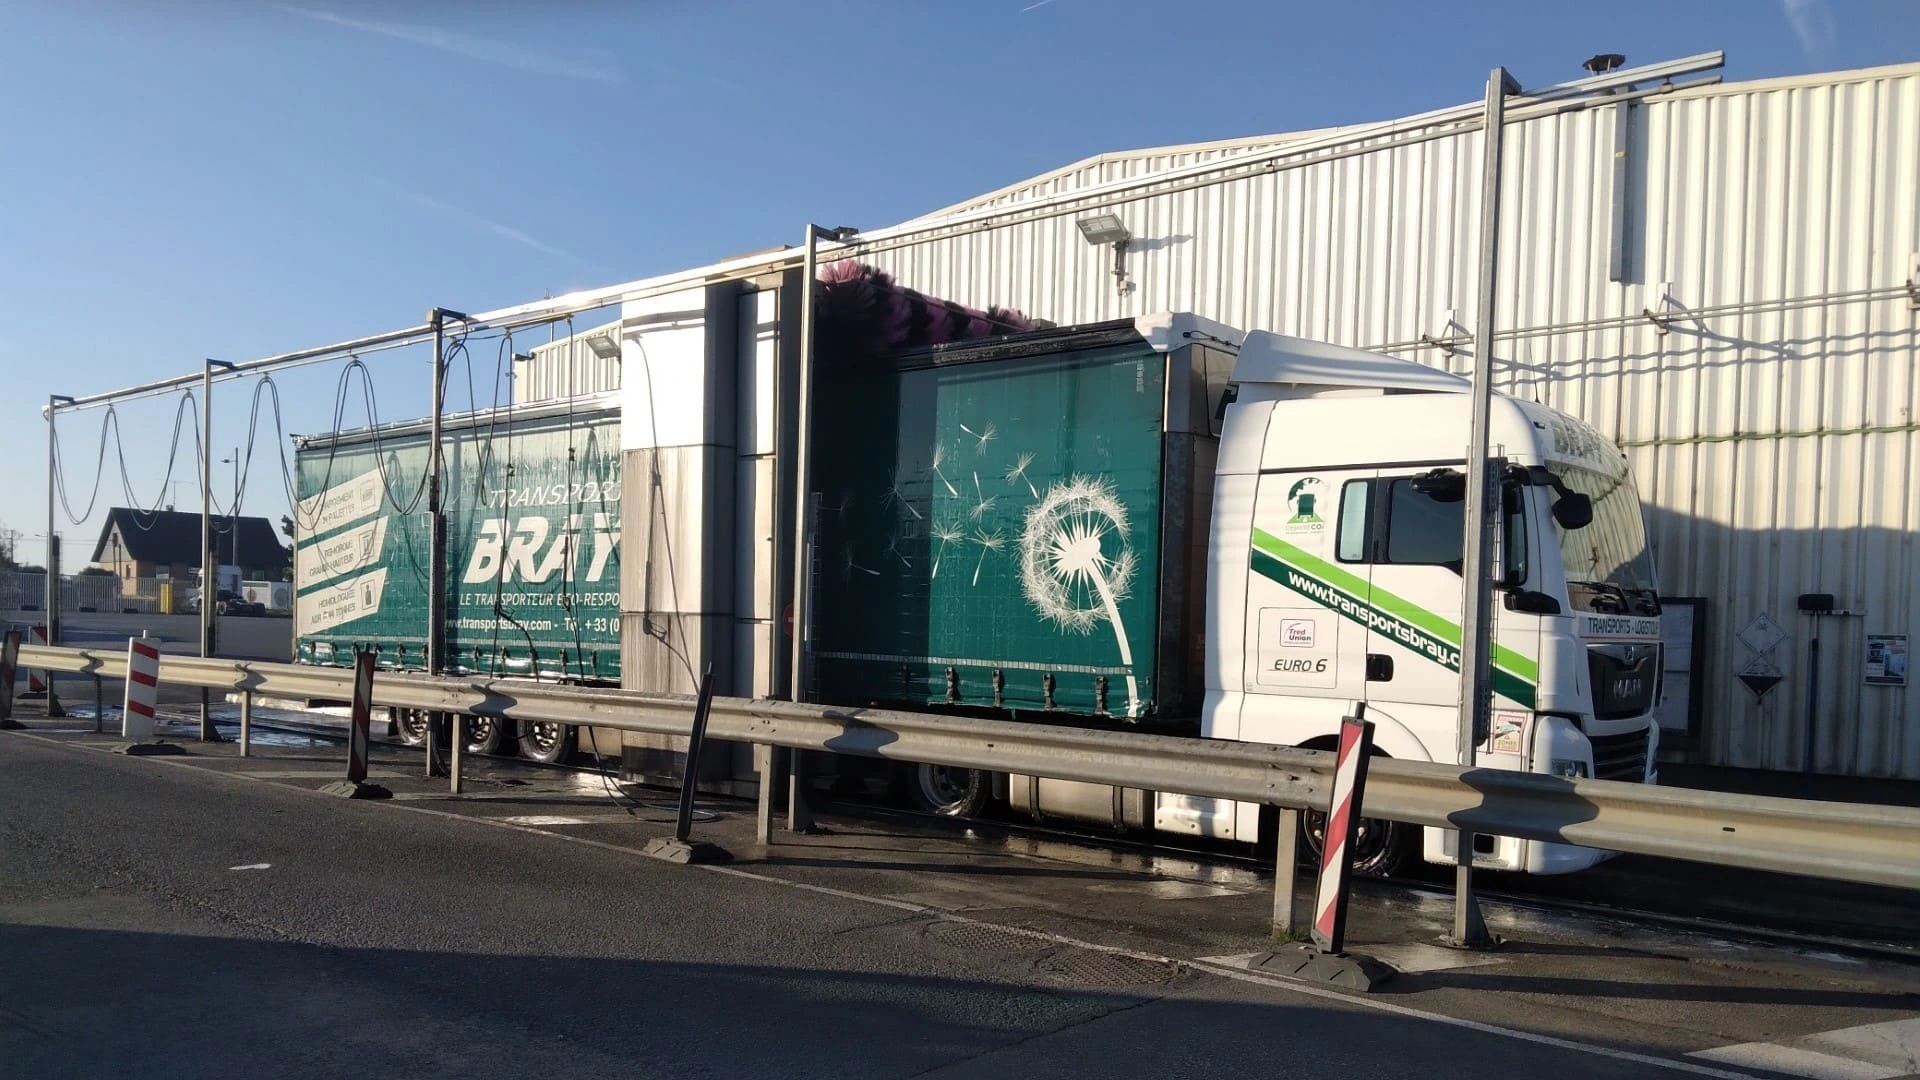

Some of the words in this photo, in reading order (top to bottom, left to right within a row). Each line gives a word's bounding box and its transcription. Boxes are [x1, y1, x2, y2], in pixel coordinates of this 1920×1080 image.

[490, 480, 621, 508] TRANSPOR
[463, 513, 621, 583] BRAY
[460, 593, 471, 605] LE
[594, 618, 607, 632] 33
[1588, 617, 1630, 634] TRANSPORTS
[1274, 659, 1312, 672] EURO
[1316, 658, 1328, 672] 6
[1613, 679, 1641, 699] MAN
